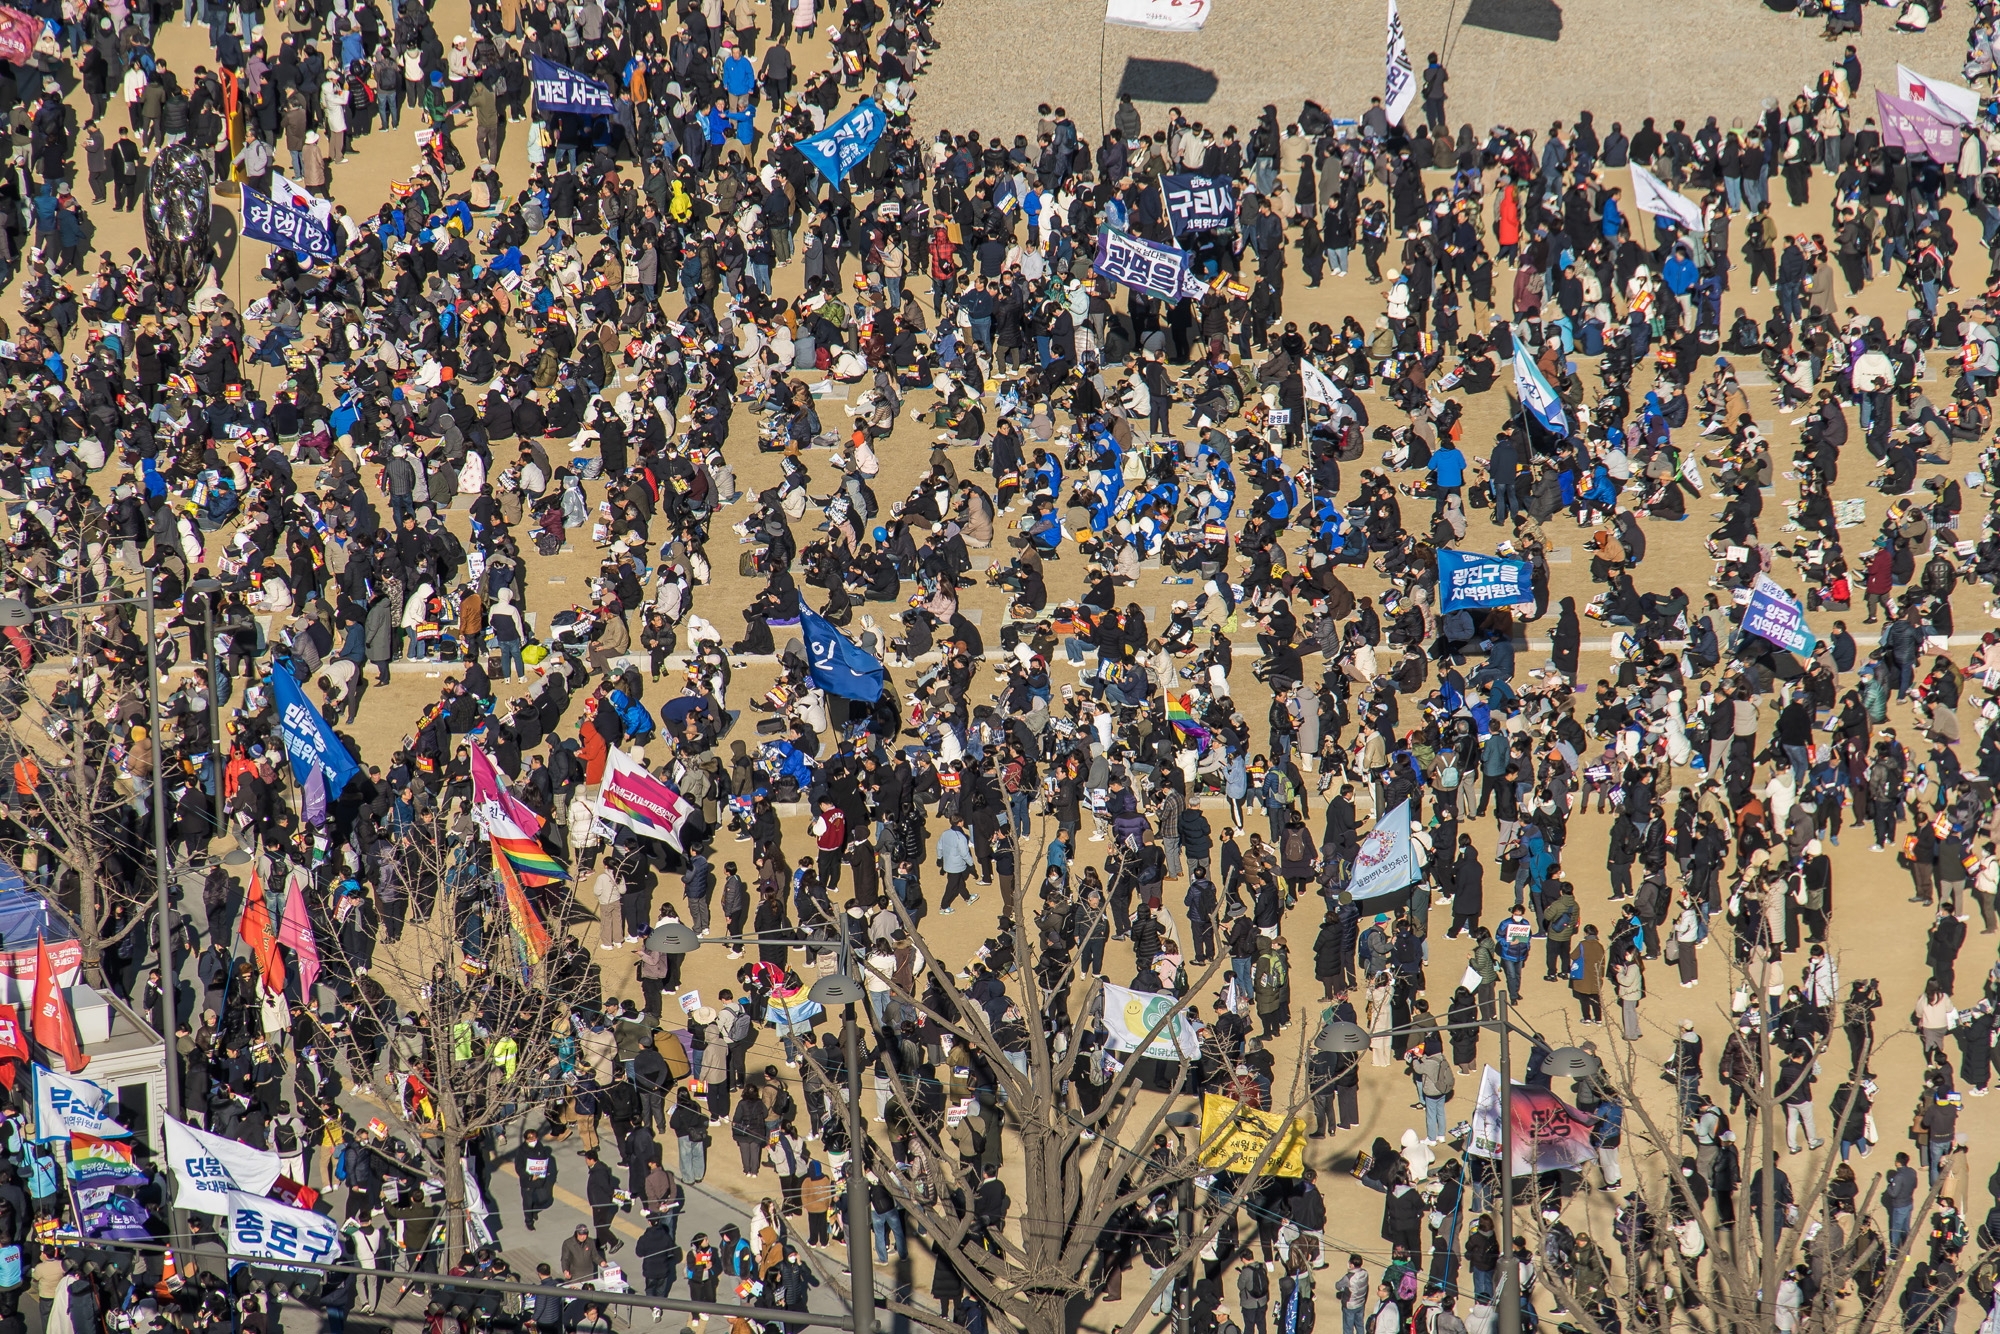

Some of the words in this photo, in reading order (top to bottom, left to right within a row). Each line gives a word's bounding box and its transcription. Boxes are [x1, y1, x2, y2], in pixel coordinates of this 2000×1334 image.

[537, 80, 568, 104] 대전
[1924, 129, 1954, 146] 행동
[1169, 187, 1234, 218] 구리시
[1105, 243, 1176, 295] 광명을
[1452, 564, 1519, 587] 광진구을
[1451, 583, 1522, 602] 지역위원회
[1761, 582, 1785, 600] 민주당
[1764, 603, 1801, 631] 양주시
[1750, 614, 1807, 651] 지역위원회
[235, 1209, 335, 1263] 종로구
